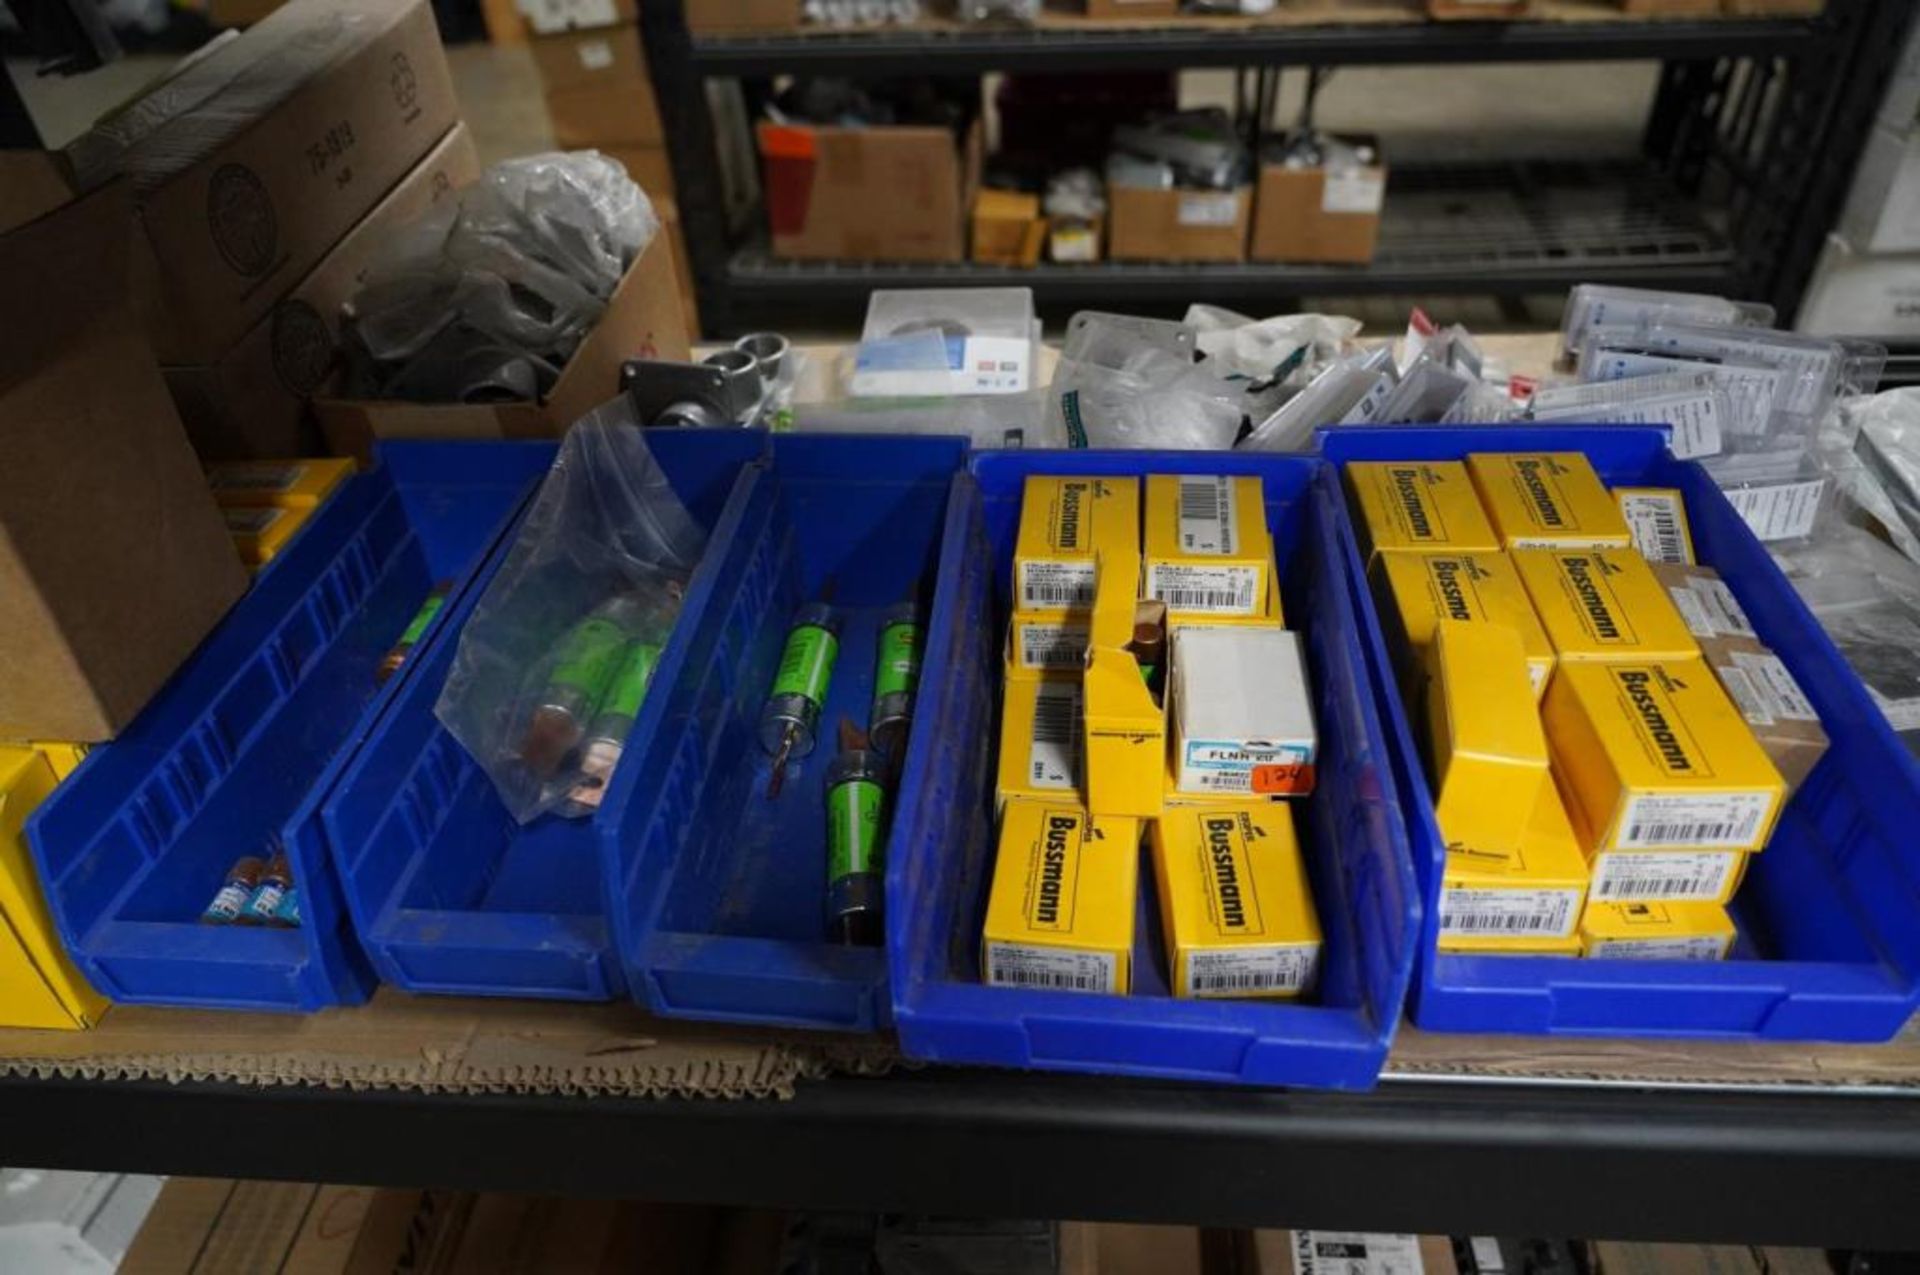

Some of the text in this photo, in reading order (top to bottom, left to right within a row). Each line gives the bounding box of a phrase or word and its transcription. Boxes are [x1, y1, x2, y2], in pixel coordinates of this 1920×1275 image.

[1060, 483, 1087, 548] Bussmann
[1393, 470, 1431, 538] Bussmann
[1515, 461, 1563, 526] Bussmann
[1562, 557, 1621, 639] Bussmann
[1618, 671, 1691, 771] Bussmann
[1038, 816, 1076, 922] Bussmann
[1207, 818, 1245, 927] Bussmann
